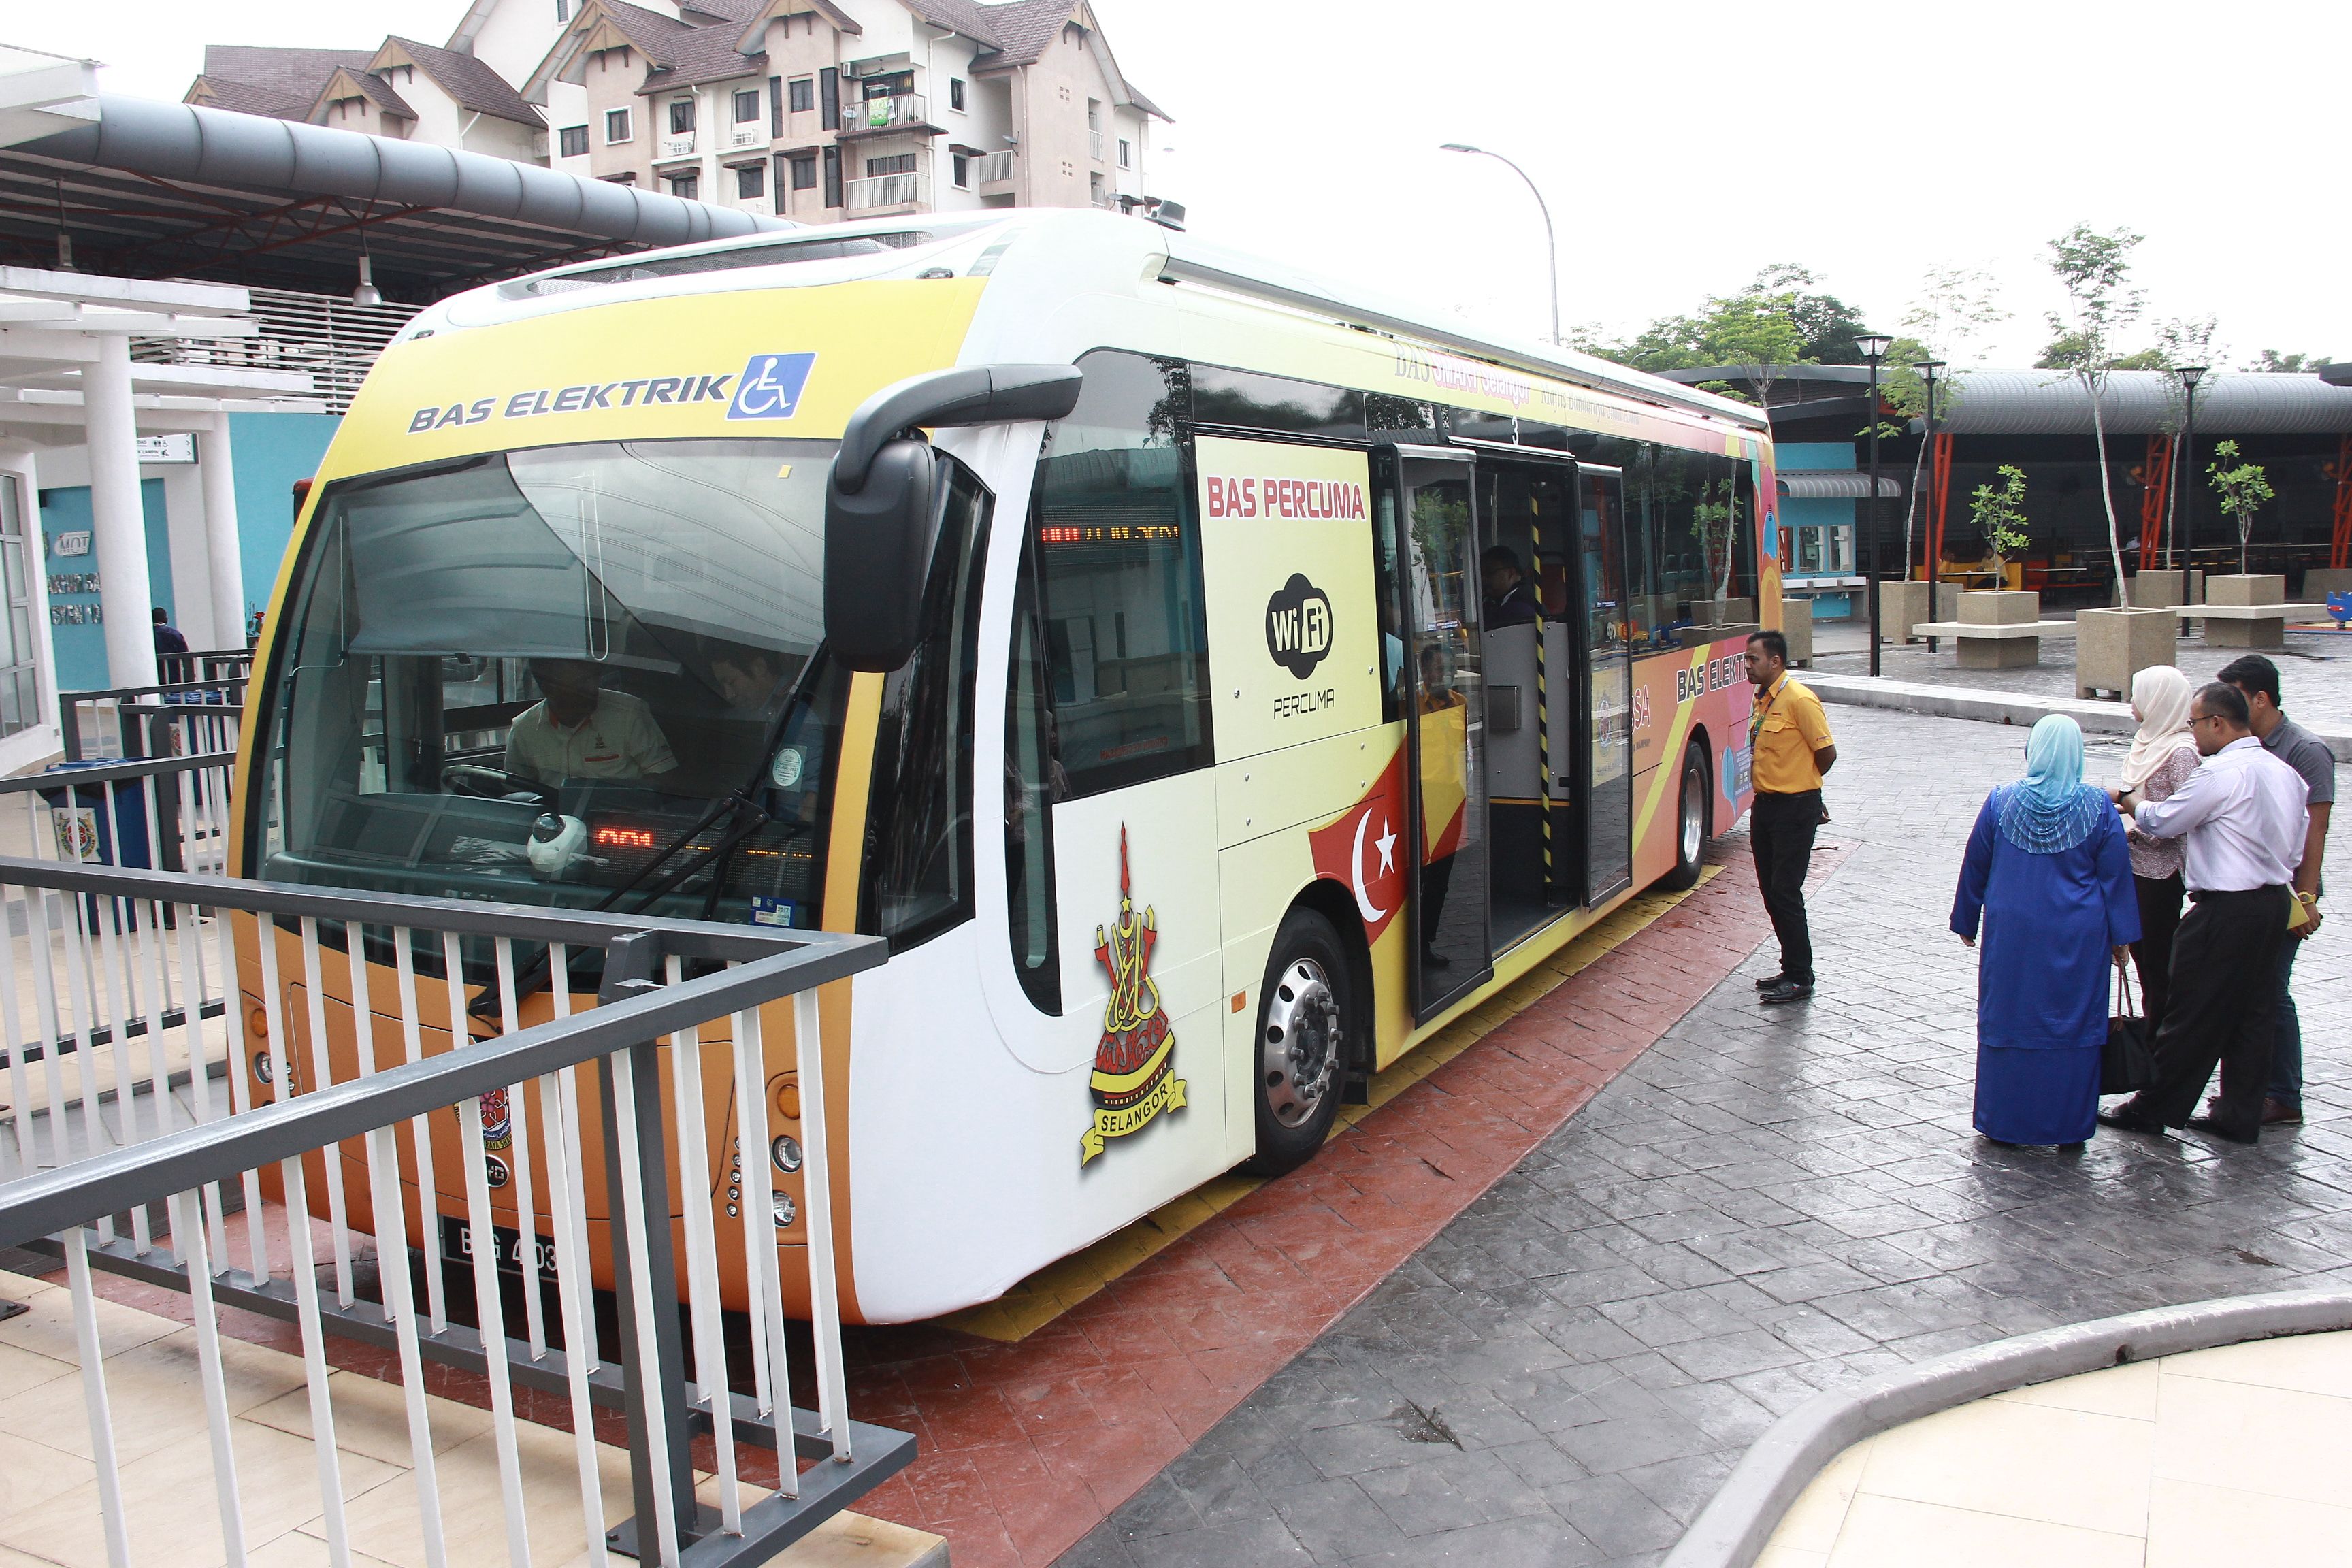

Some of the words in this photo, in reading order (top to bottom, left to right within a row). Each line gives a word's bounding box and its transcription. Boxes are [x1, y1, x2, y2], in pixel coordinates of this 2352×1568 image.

[1394, 341, 1430, 383] BAS
[1480, 363, 1530, 410] Selangor
[408, 397, 497, 434] BAS
[504, 374, 734, 419] ELEKTRIK
[1512, 416, 1519, 446] 3
[1207, 476, 1256, 517] BAS
[1263, 479, 1365, 519] PERCUMA
[1274, 688, 1334, 720] PERCUMA
[1677, 664, 1705, 704] BAS
[1101, 1083, 1168, 1132] SELANGOR
[461, 1227, 501, 1261] BG
